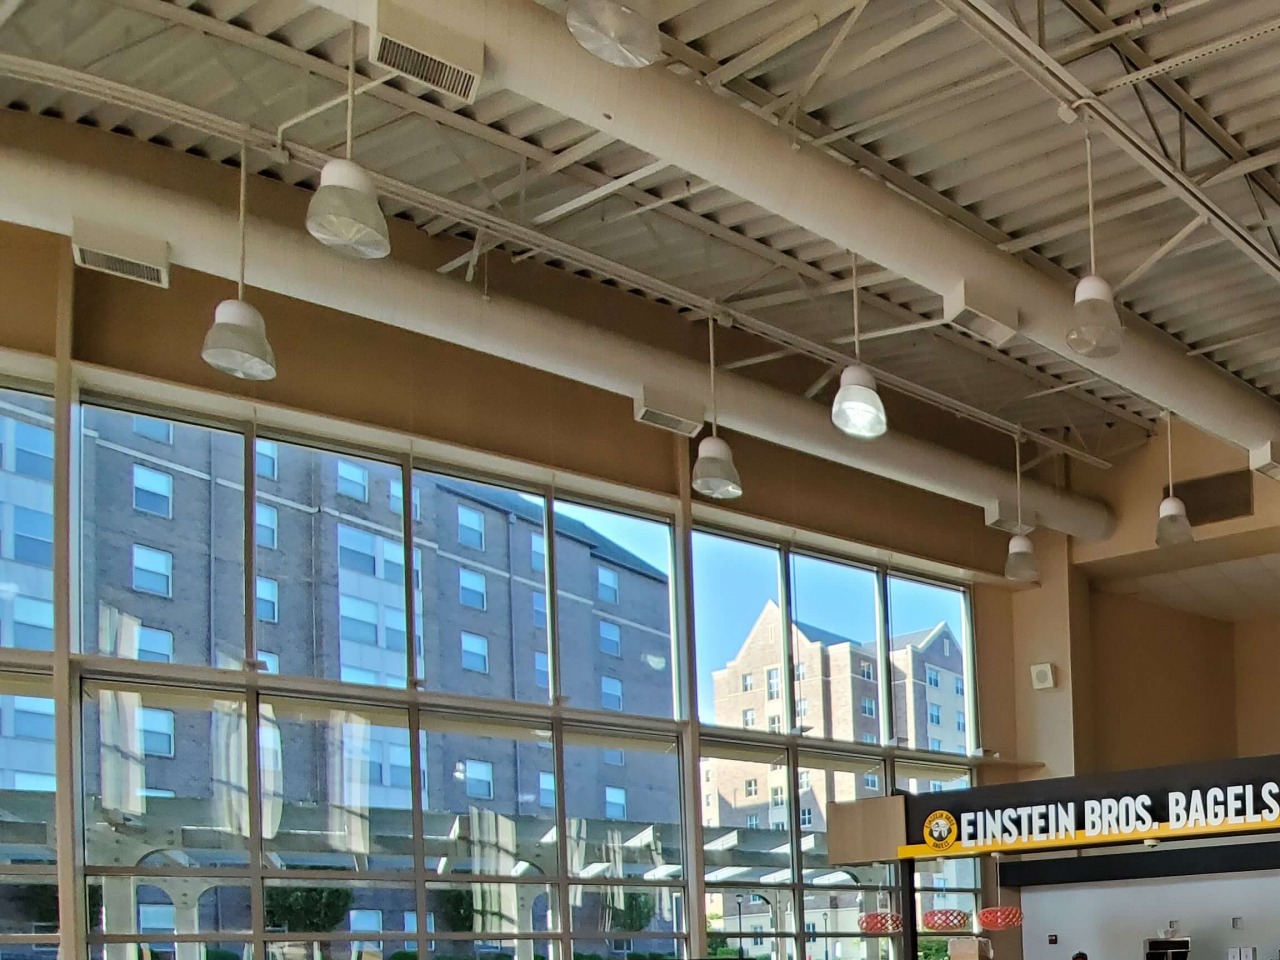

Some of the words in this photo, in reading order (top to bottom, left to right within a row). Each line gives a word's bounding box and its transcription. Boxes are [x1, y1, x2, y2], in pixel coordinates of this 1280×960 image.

[961, 802, 1077, 848] EINSTEIN
[1084, 794, 1160, 837] BROS.
[1168, 781, 1280, 830] BAGELS
